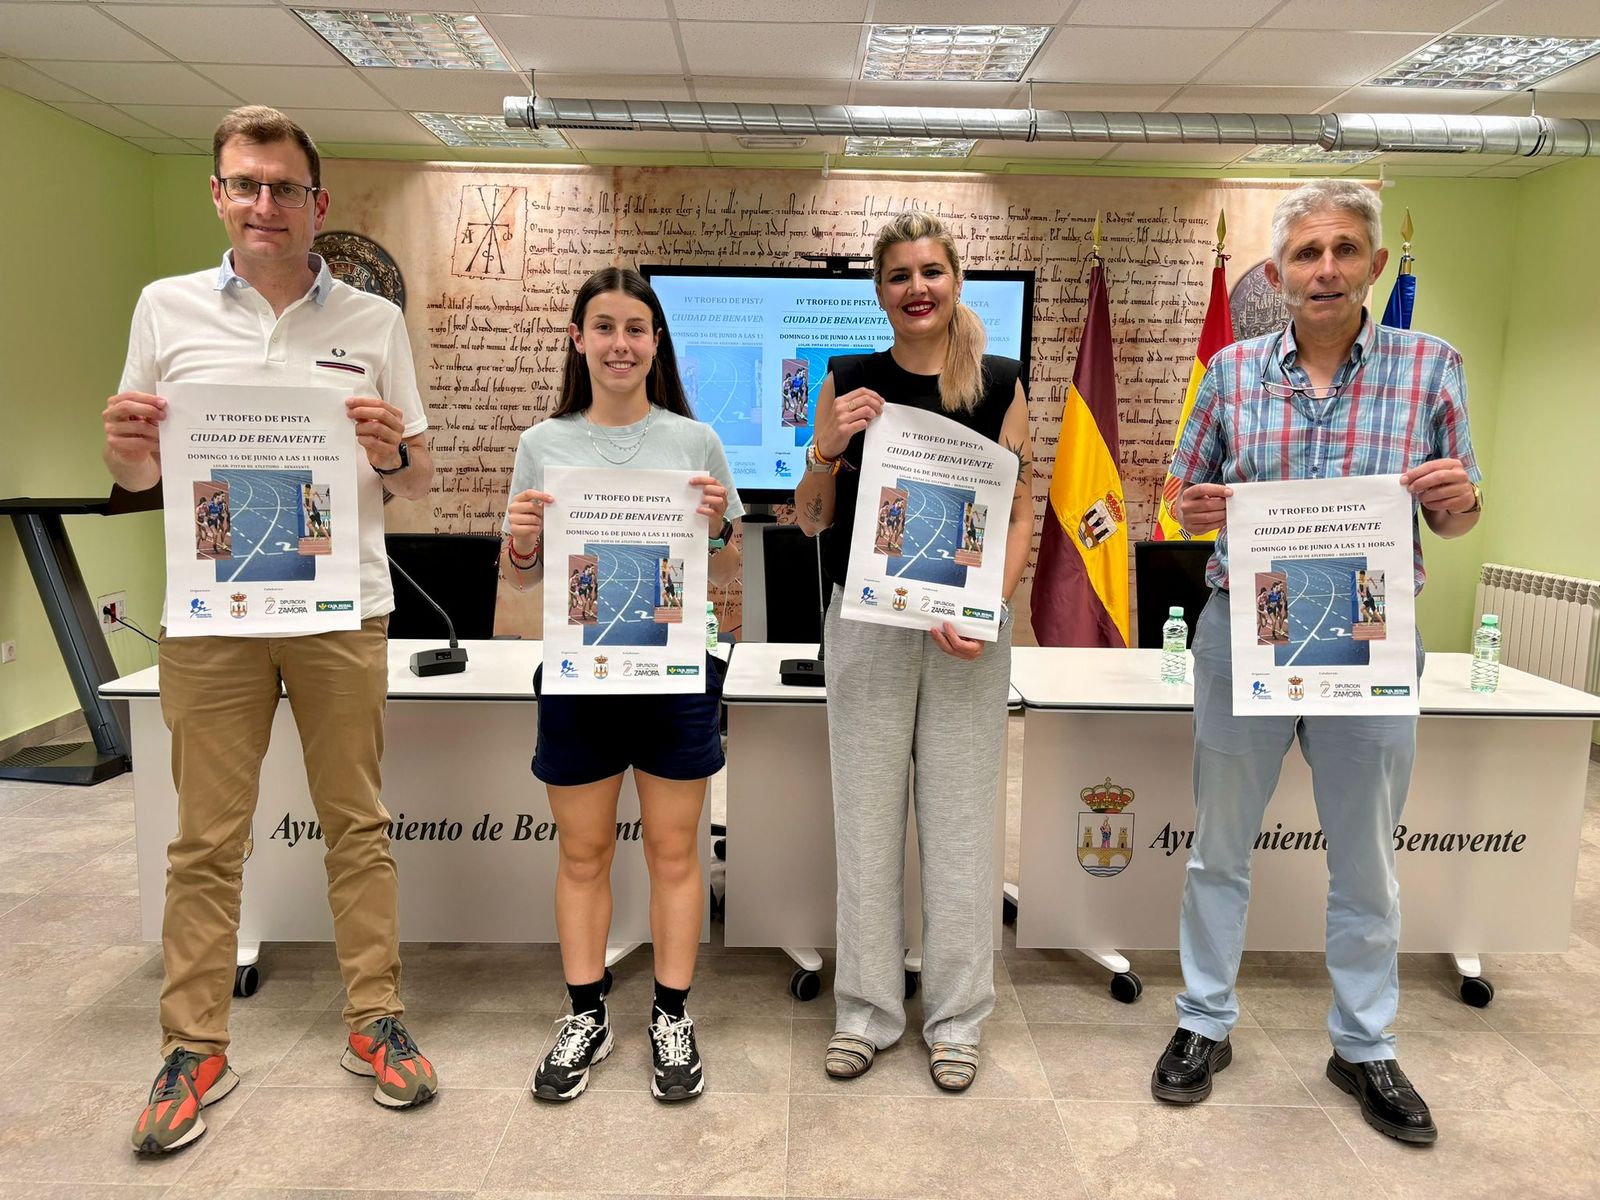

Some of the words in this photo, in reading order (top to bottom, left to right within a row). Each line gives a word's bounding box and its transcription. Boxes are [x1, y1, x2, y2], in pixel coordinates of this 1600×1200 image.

[672, 314, 707, 322] CIUDAD
[708, 314, 721, 322] DE
[783, 316, 818, 324] CIUDAD
[820, 316, 833, 324] DE
[833, 317, 888, 325] BENAVENTE
[206, 414, 216, 422] IV
[219, 414, 262, 422] TROFEO
[281, 415, 311, 423] PISTA
[190, 434, 236, 442] CIUDAD
[238, 434, 256, 443] DE
[257, 435, 326, 444] BENAVENTE
[913, 433, 945, 444] TROFEO
[960, 441, 984, 451] PISTA
[253, 454, 277, 462] JUNIO
[887, 446, 922, 459] CIUDAD
[923, 452, 937, 461] DE
[937, 454, 994, 470] BENAVENTE
[881, 462, 912, 473] DOMINGO
[931, 470, 949, 479] JUNIO
[978, 478, 1001, 486] HORAS
[595, 494, 631, 502] TROFEO
[646, 495, 671, 503] PISTA
[1280, 507, 1319, 515] TROFEO
[1321, 505, 1335, 513] DE
[1337, 504, 1366, 512] PISTA
[570, 511, 608, 520] CIUDAD
[609, 512, 624, 520] DE
[625, 512, 683, 521] BENAVENTE
[1254, 526, 1295, 536] CIUDAD
[1297, 525, 1312, 534] DE
[1314, 522, 1381, 533] BENAVENTE
[1251, 545, 1287, 553] DOMINGO
[1310, 543, 1333, 551] JUNIO
[931, 607, 956, 616] ZAMORA
[1333, 690, 1363, 698] ZAMORA
[269, 812, 463, 848] Ayuiento
[472, 813, 504, 842] de
[1392, 824, 1526, 852] Benavente
